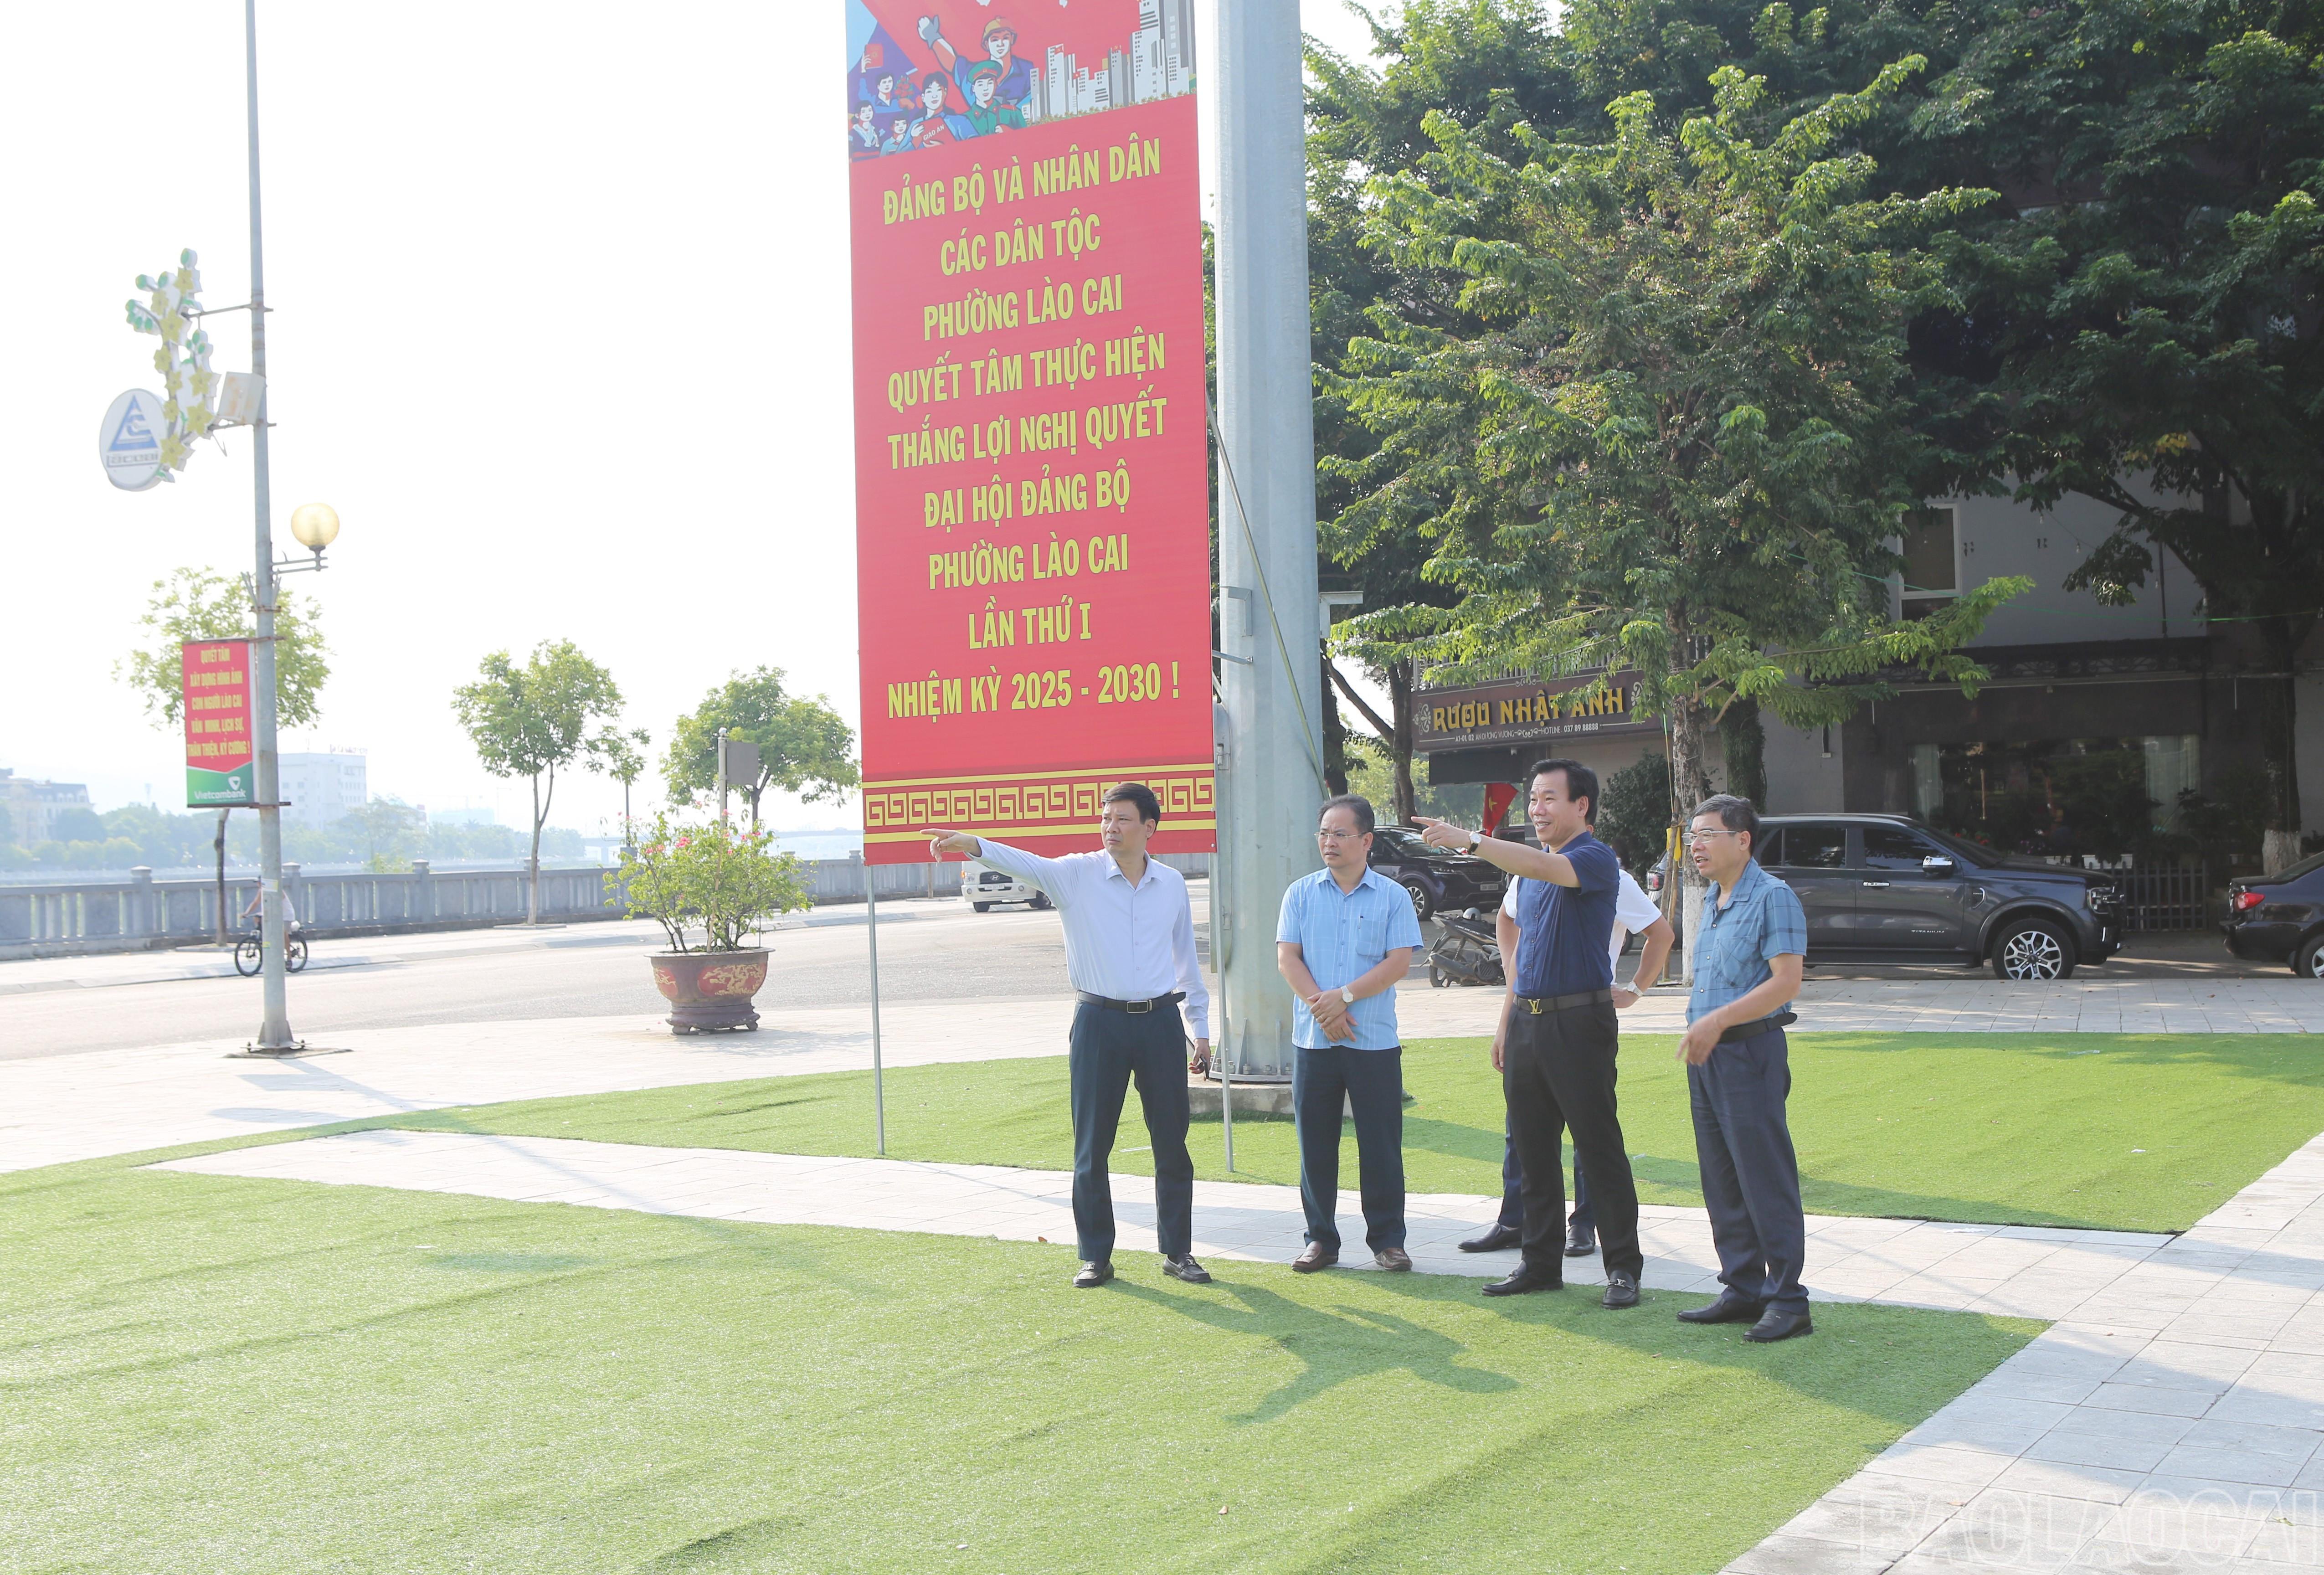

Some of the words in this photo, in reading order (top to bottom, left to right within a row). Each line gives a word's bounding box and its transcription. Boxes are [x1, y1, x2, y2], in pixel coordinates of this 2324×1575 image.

[884, 173, 946, 225] ĐẢNG
[953, 163, 985, 215] BỘ
[993, 156, 1024, 203] VÀ
[1033, 144, 1100, 196] NHÂN
[1109, 132, 1160, 182] DÂN
[941, 228, 987, 276] CÁC
[995, 218, 1044, 267] DÂN
[1051, 207, 1100, 261] TỘC
[924, 288, 1018, 341] PHƯỜNG
[1027, 277, 1074, 324] LÀO
[1082, 274, 1122, 315] CAI
[888, 350, 963, 413] QUYẾT
[970, 348, 1023, 396] TÂM
[1030, 338, 1096, 390] THỰC
[1105, 325, 1165, 380] HIỆN
[887, 415, 965, 469] THẮNG
[973, 415, 1011, 464] LỢI
[1020, 410, 1076, 455] NGHỊ
[1085, 384, 1167, 449] QUYẾT
[924, 489, 963, 533] ĐẠI
[972, 474, 1013, 527] HỘI
[1021, 464, 1087, 516] ĐẢNG
[1096, 458, 1130, 513] BỘ
[929, 539, 1024, 590] PHƯỜNG
[1033, 532, 1080, 579] LÀO
[1088, 534, 1128, 574] CAI
[969, 596, 1014, 649] LẦN
[1022, 595, 1073, 644] THỨ
[1079, 603, 1091, 639] I
[888, 670, 962, 723] NHIỆM
[971, 665, 1002, 712] KỲ
[1011, 669, 1072, 710] 2025
[1098, 663, 1161, 704] 2030
[1433, 700, 1490, 733] RƯỢU
[1564, 725, 1573, 733] 037
[1574, 724, 1581, 732] 89
[1582, 722, 1599, 731] 88888
[194, 788, 246, 800] Vietcombank
